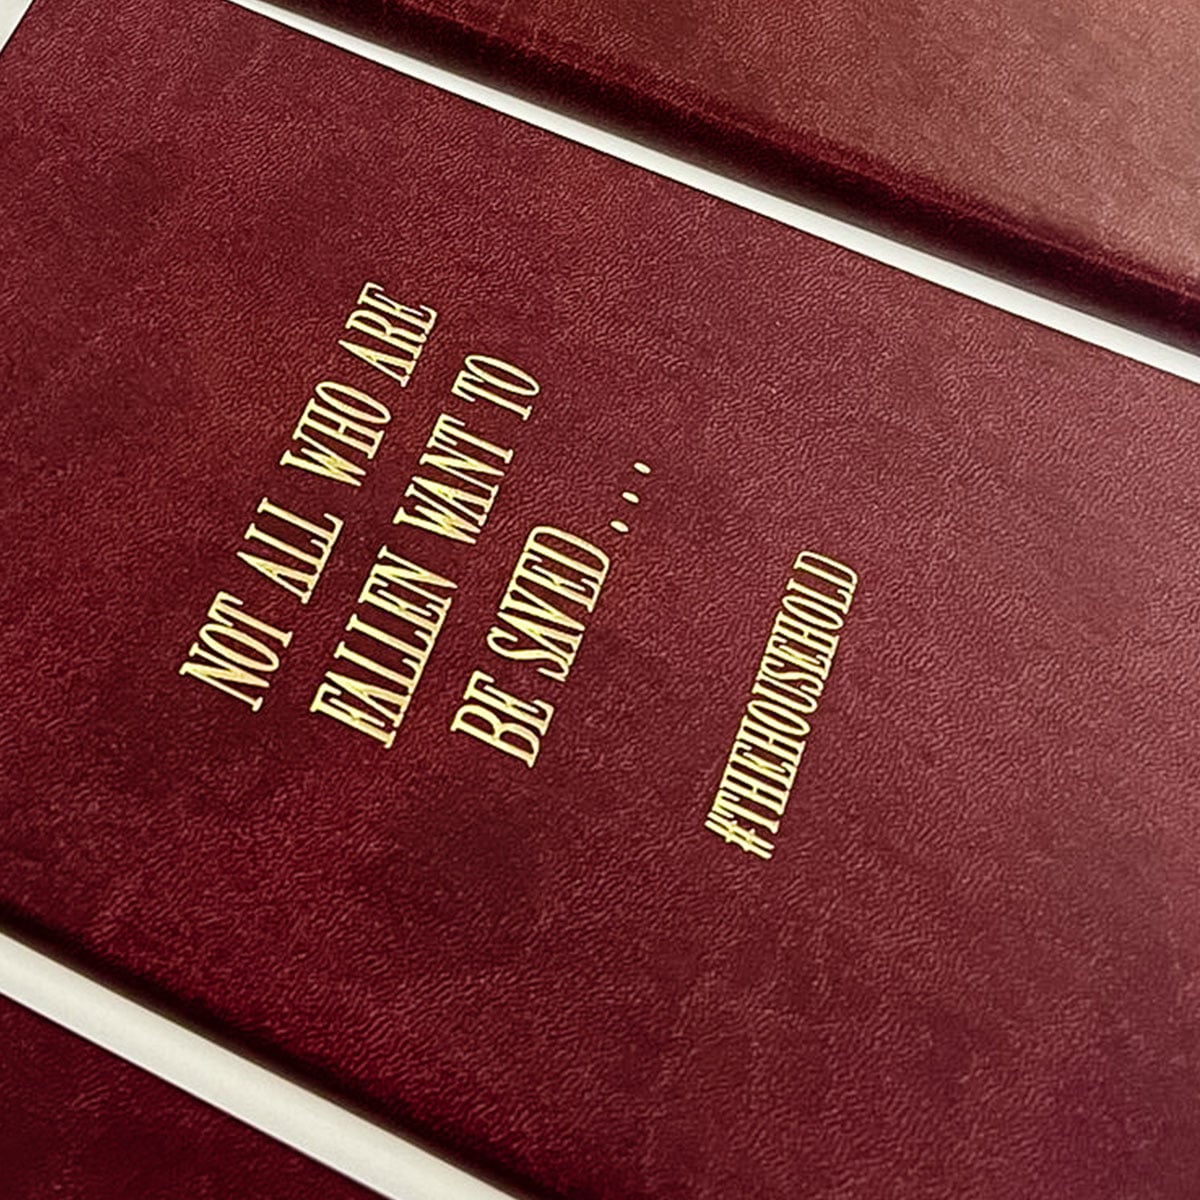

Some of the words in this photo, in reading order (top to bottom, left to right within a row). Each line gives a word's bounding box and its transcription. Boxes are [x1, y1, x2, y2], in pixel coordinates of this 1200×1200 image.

[337, 281, 438, 387] ARE
[451, 353, 541, 422] TO
[279, 379, 394, 488] WHO
[392, 412, 515, 544] WANT
[236, 496, 345, 604] ALL
[178, 590, 294, 713] NOT
[309, 544, 458, 748] FALLEN
[449, 669, 556, 768] BE
[704, 549, 860, 860] #THEHOUSEHOLD
